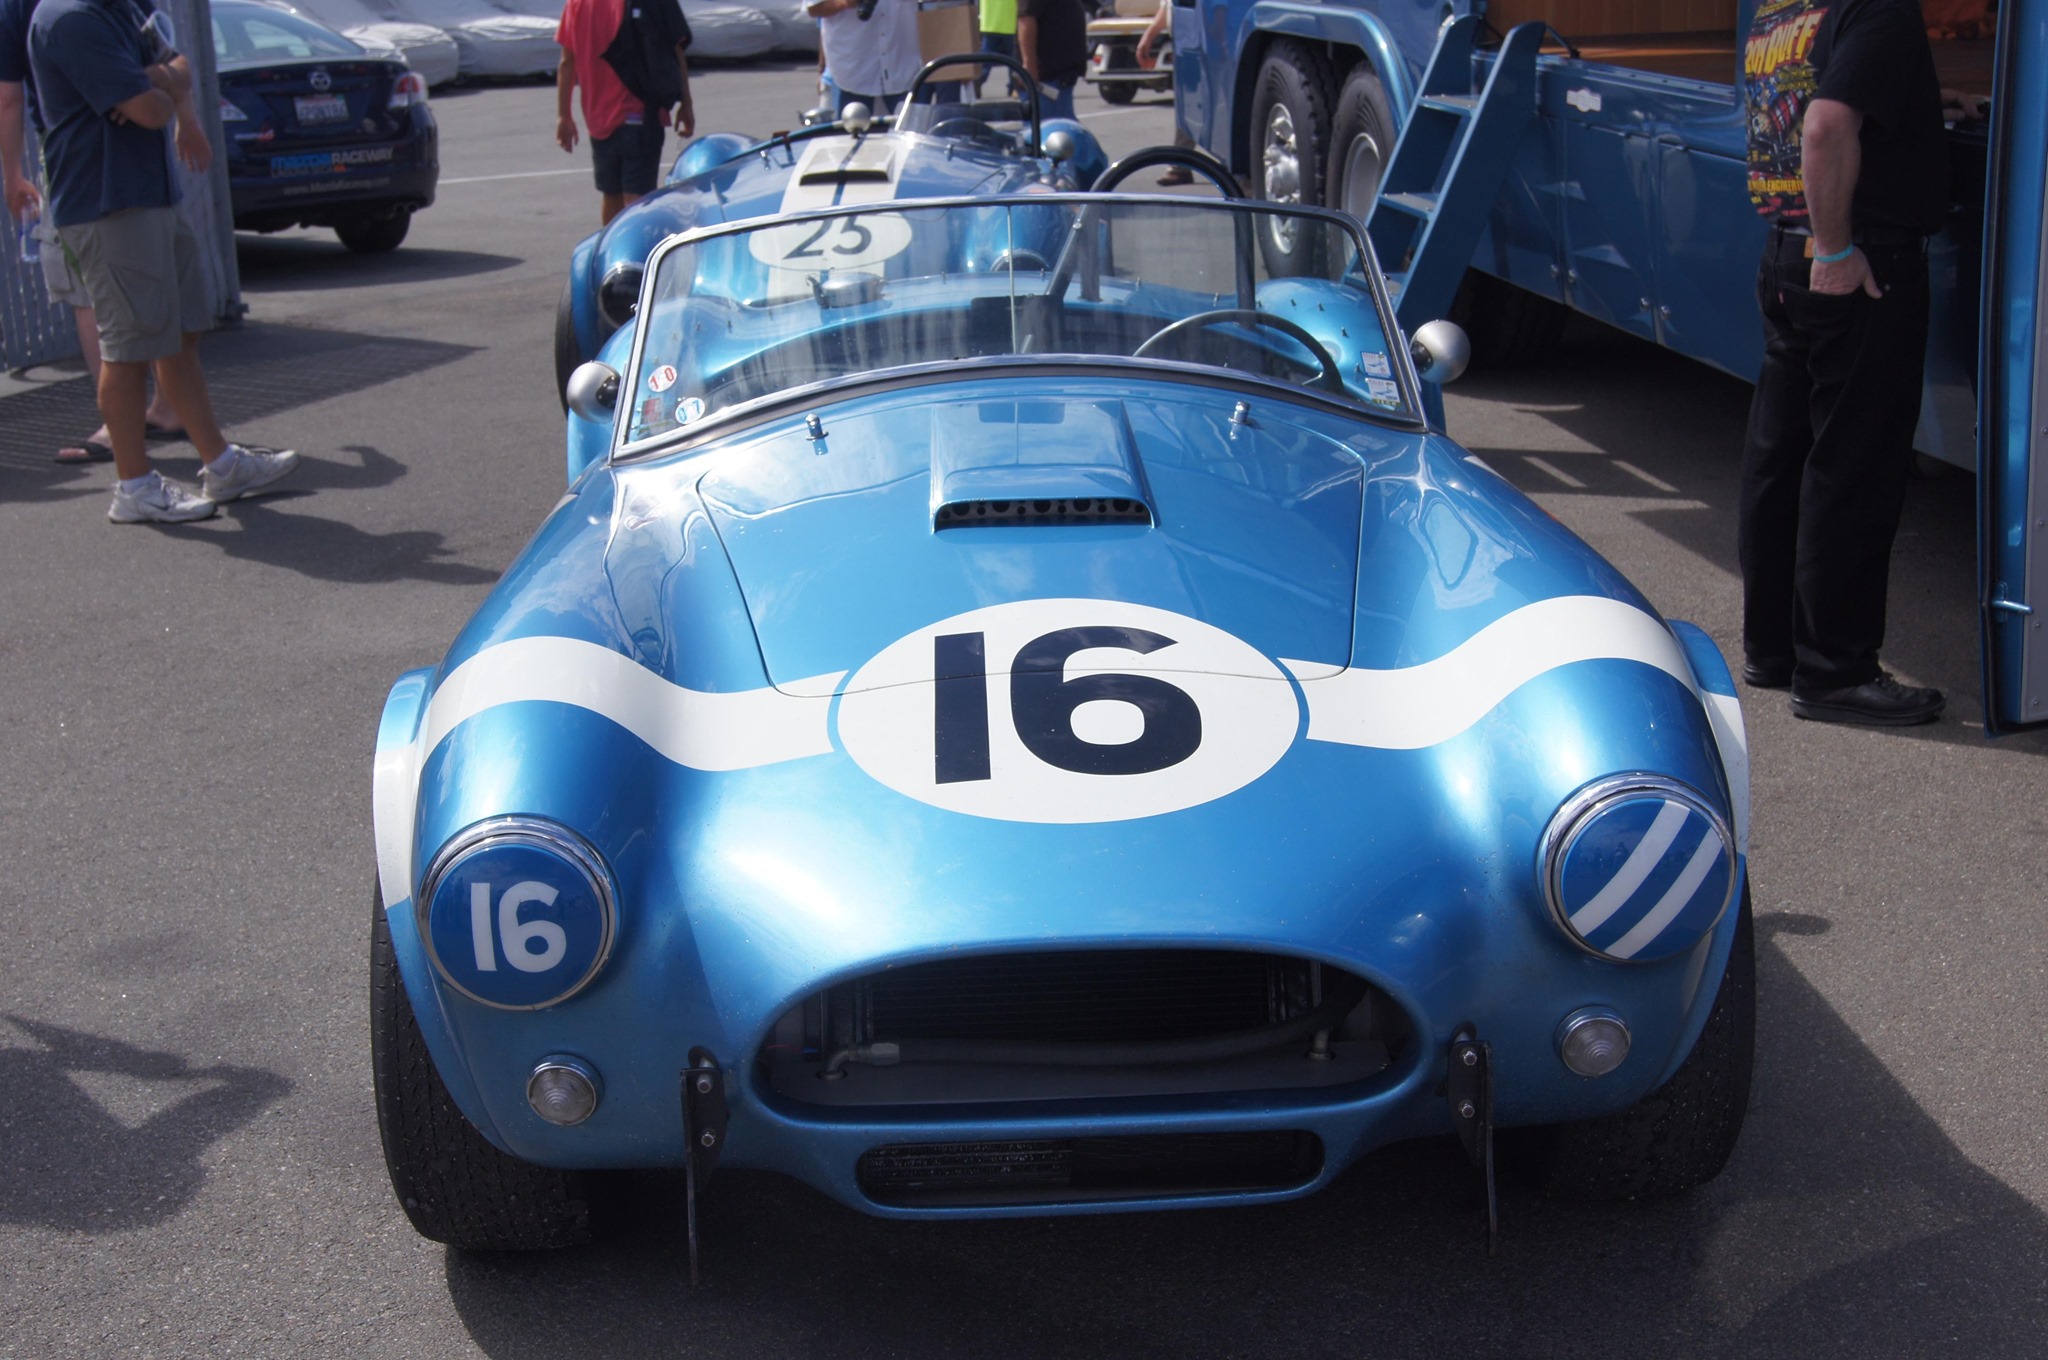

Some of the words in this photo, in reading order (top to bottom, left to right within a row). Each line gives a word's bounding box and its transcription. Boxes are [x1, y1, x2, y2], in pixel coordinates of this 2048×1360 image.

[331, 147, 394, 164] RACEWAY
[782, 215, 872, 260] 25
[934, 625, 1203, 785] 16
[471, 880, 567, 973] 16
